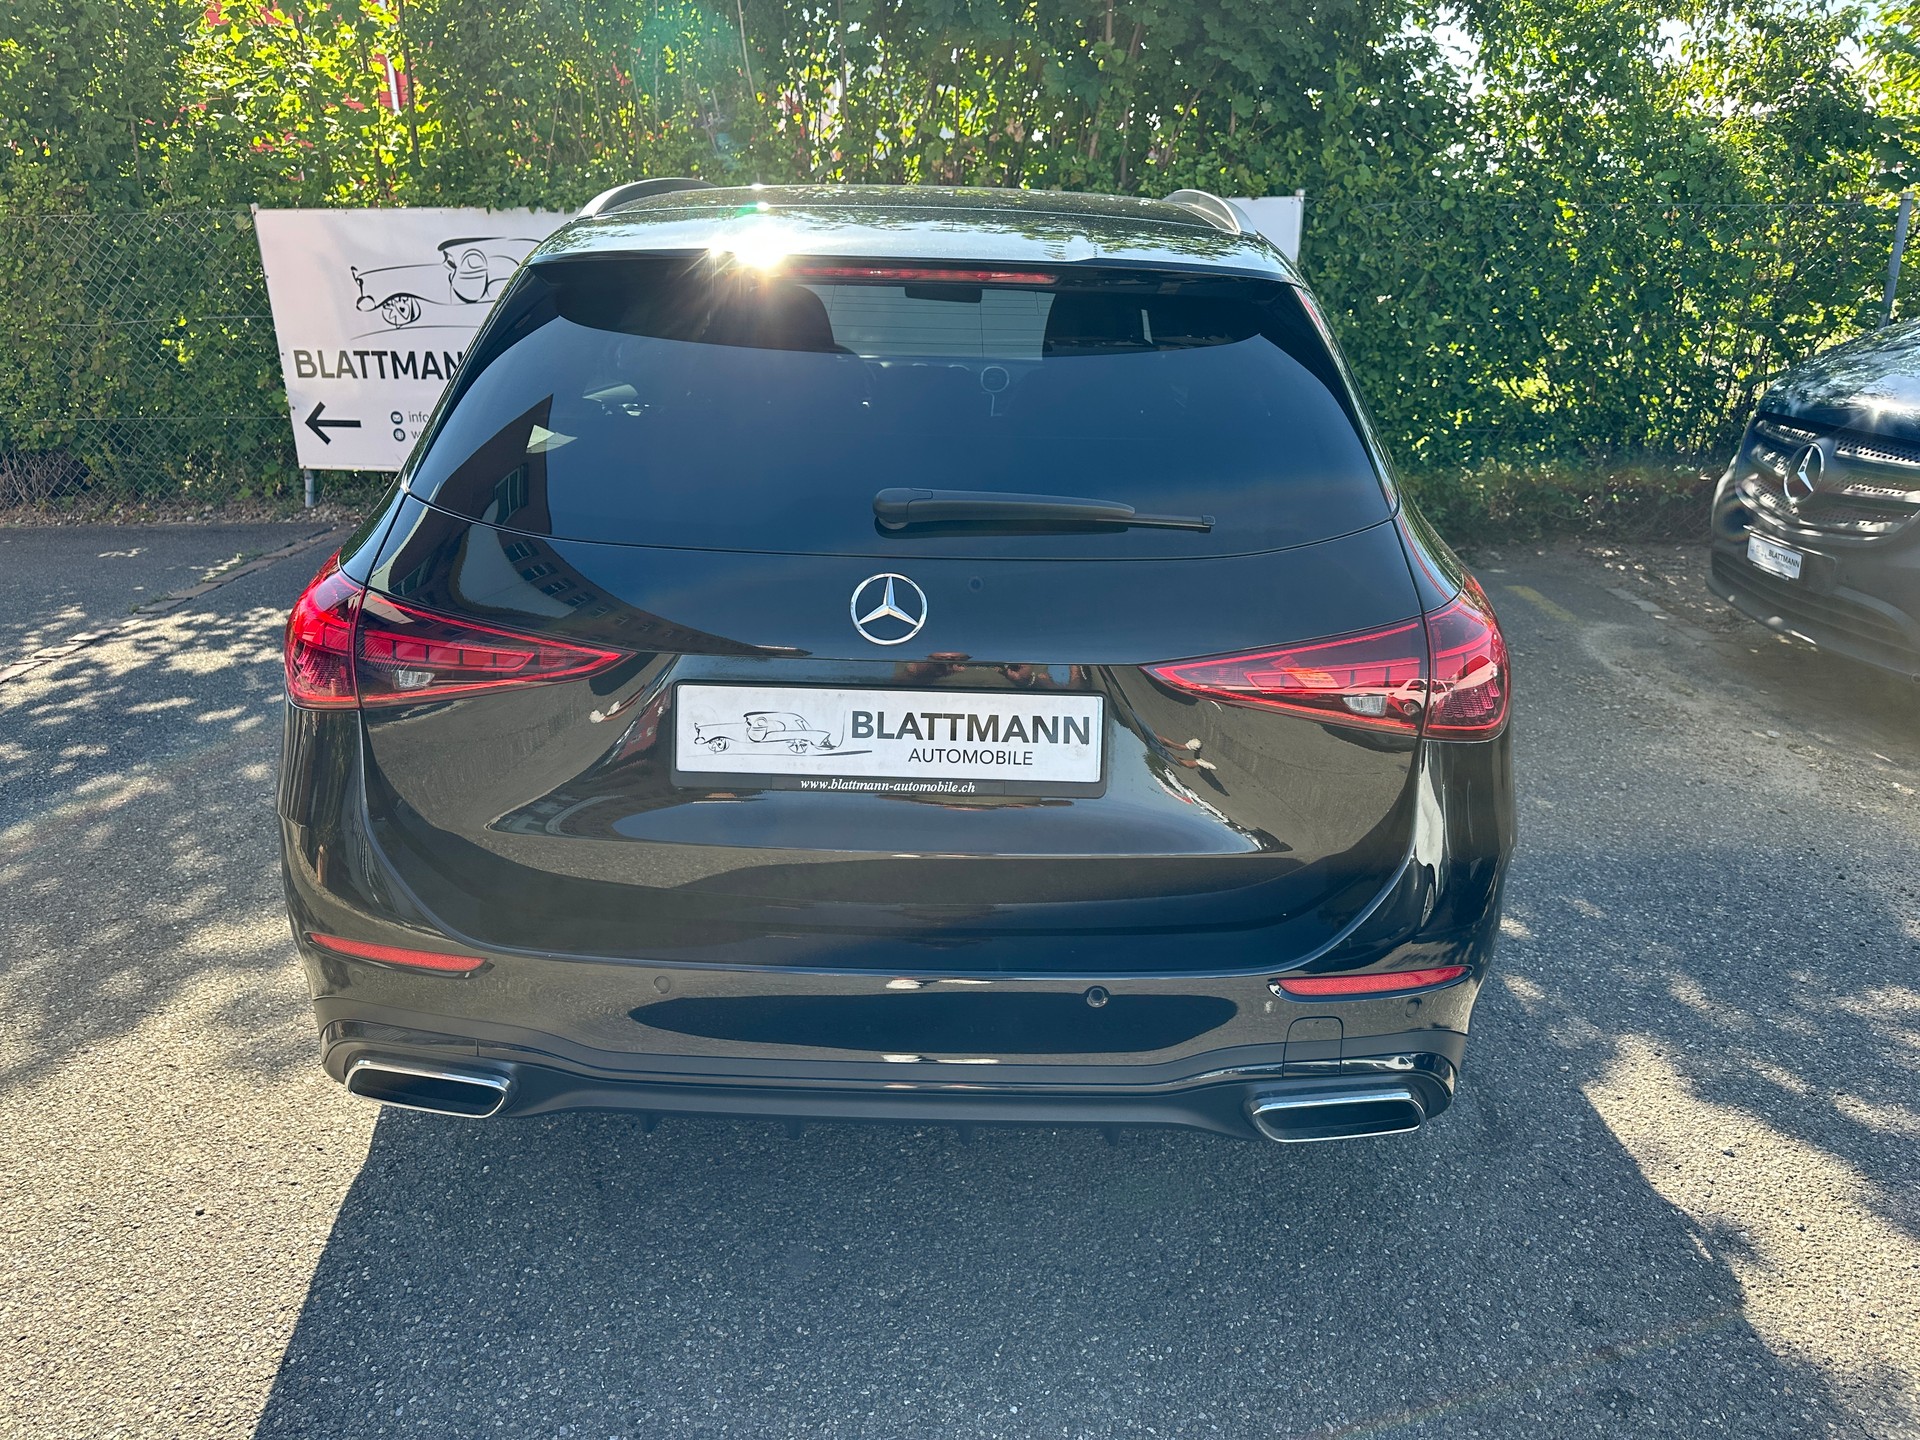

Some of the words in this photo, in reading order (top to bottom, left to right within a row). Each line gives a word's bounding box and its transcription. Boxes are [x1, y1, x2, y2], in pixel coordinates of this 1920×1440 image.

[1768, 549, 1800, 568] BLATTMANN
[851, 710, 1090, 746] BLATTMANN
[908, 748, 1033, 766] AUTOMOBILE
[800, 778, 976, 794] www.blattmann-automobile.ch
